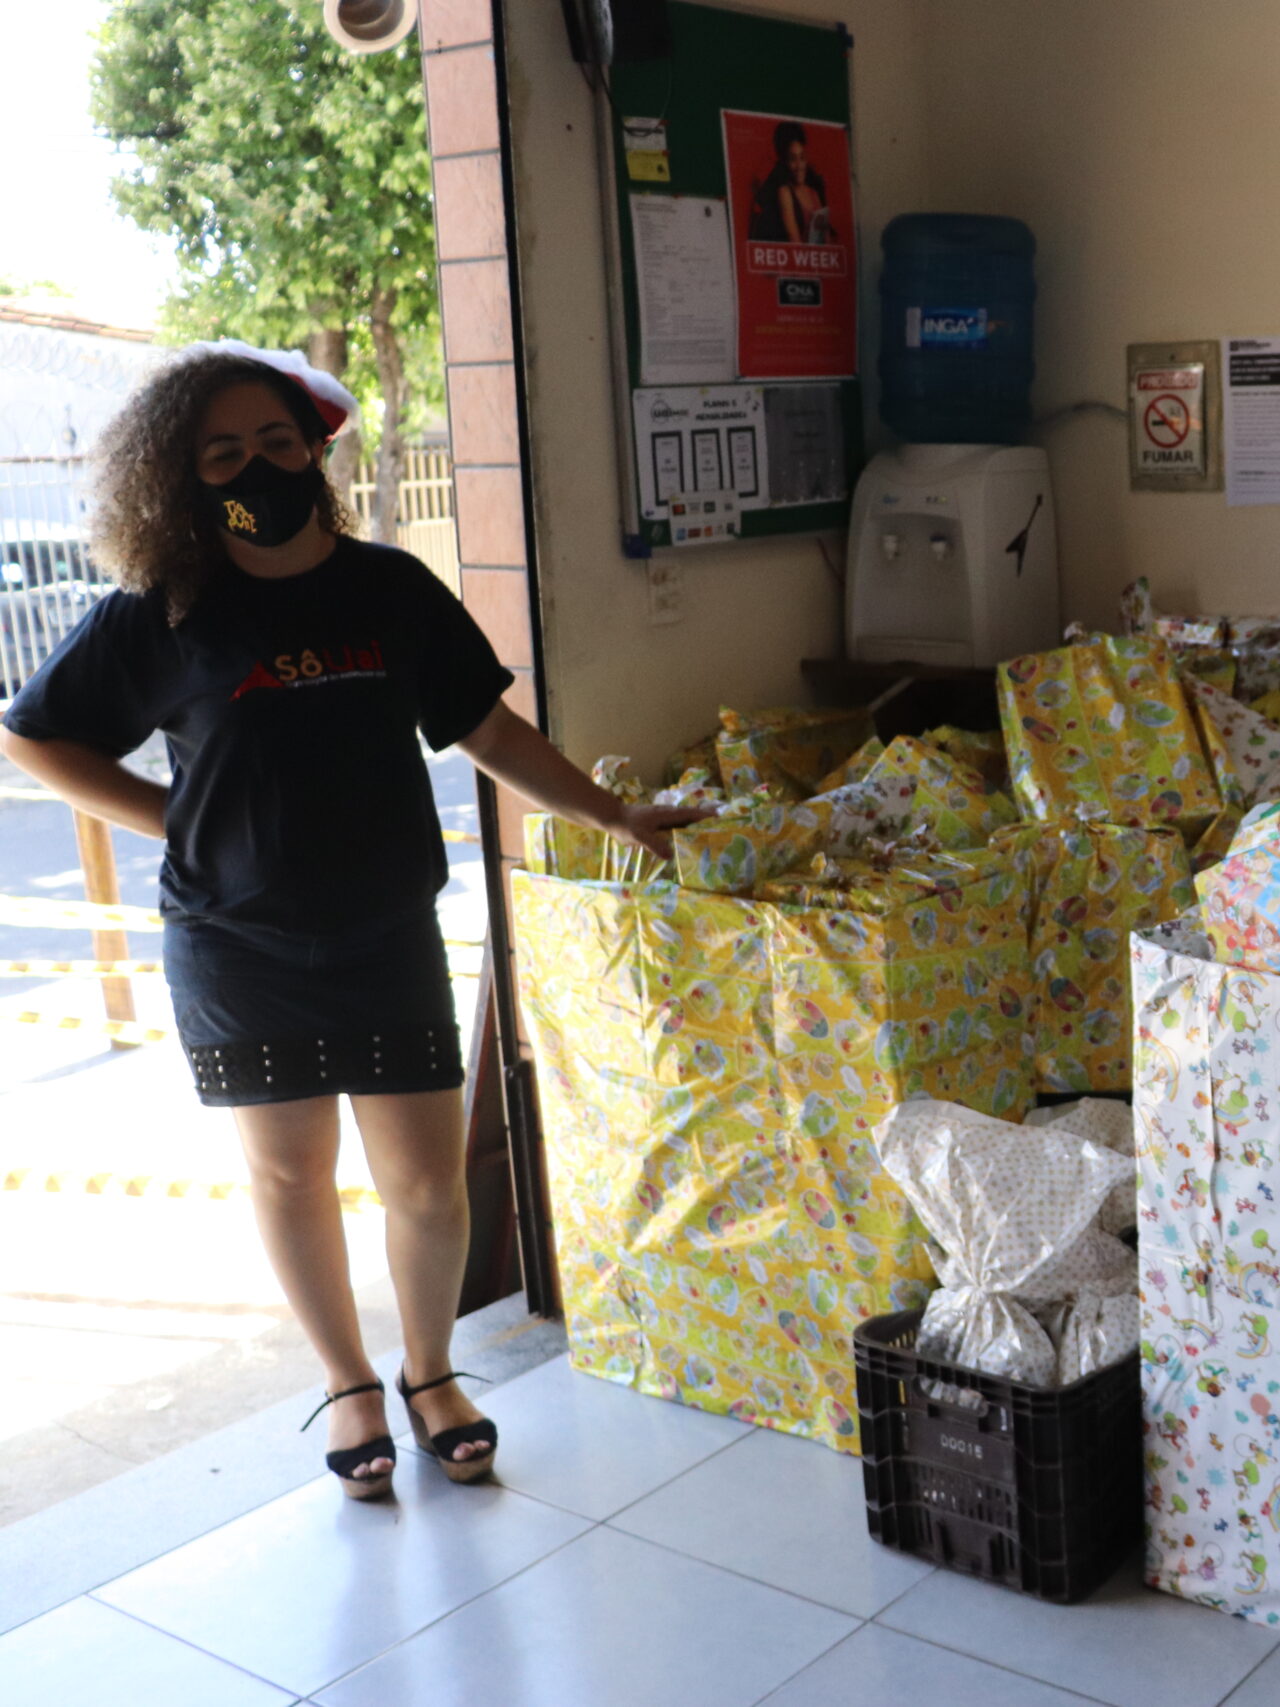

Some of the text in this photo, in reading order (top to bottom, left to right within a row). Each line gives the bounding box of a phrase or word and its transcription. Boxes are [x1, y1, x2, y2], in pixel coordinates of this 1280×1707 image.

[753, 247, 841, 269] RED WEEK
[1143, 450, 1194, 463] FUMAR
